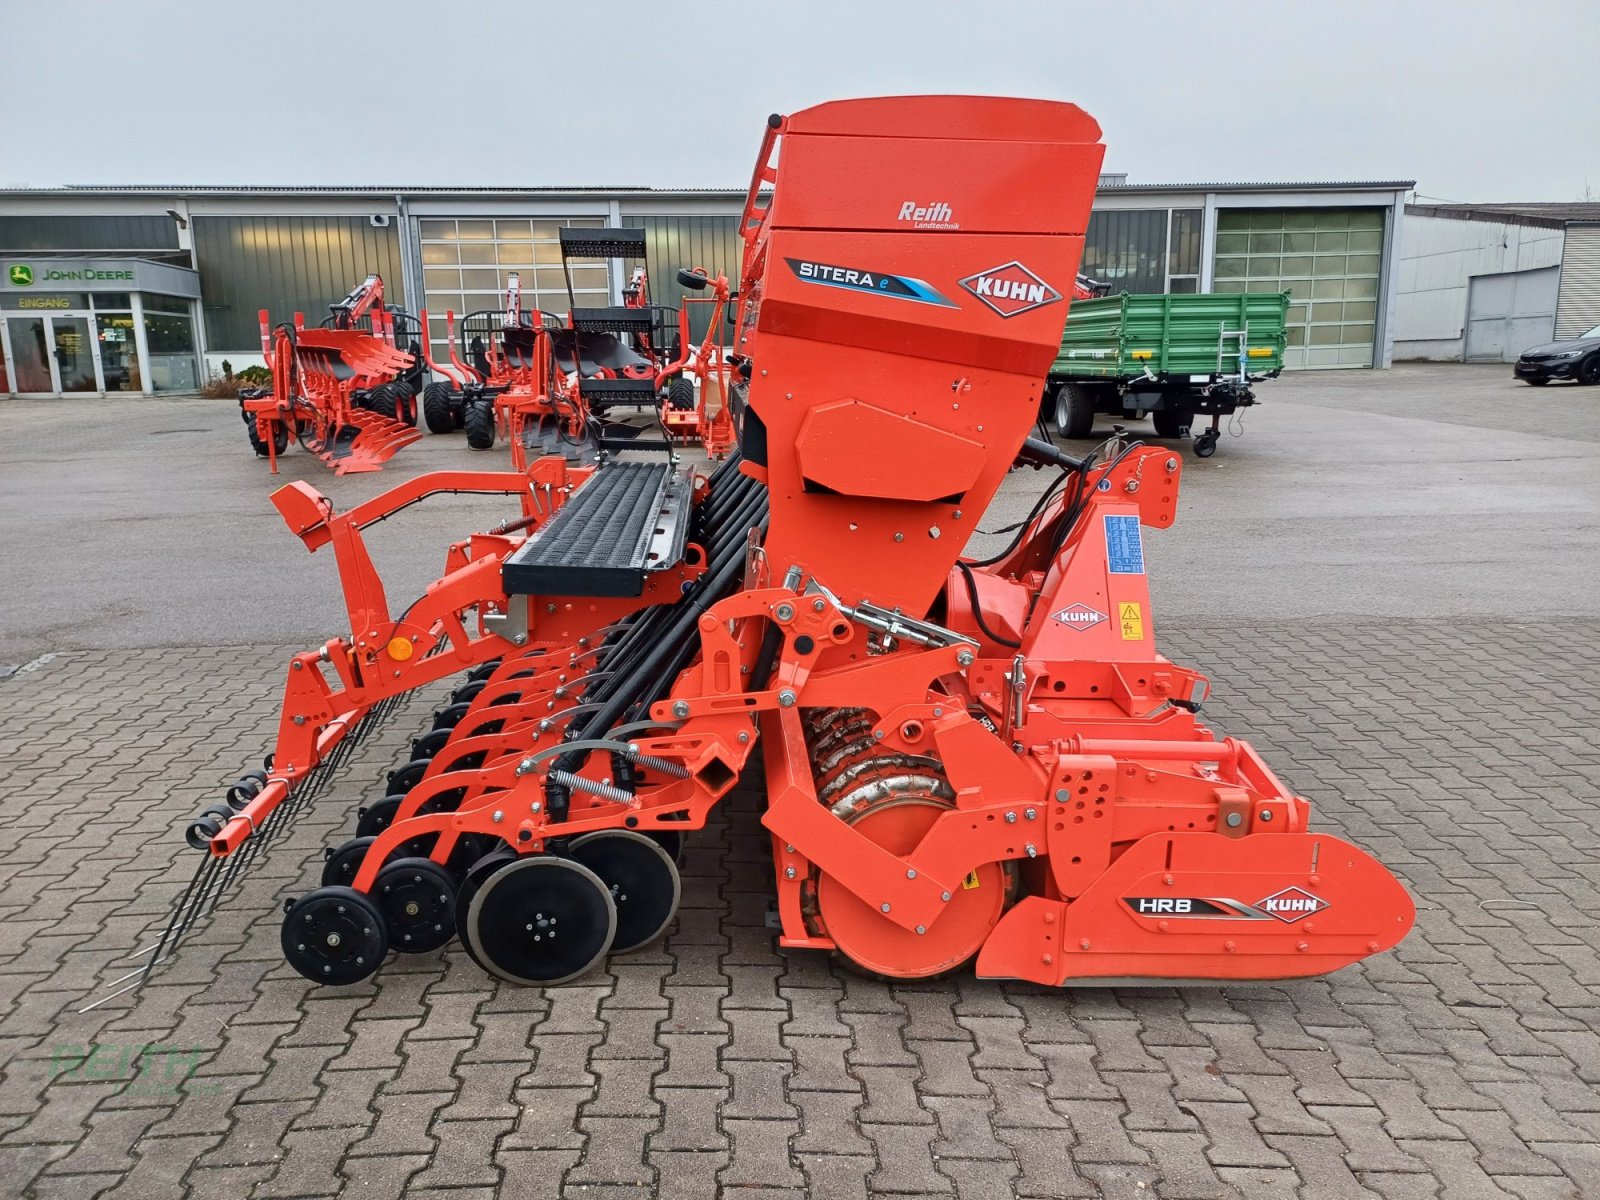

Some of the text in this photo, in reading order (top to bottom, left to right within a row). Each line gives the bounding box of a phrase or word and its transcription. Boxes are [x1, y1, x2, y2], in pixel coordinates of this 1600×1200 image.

[898, 201, 953, 222] Reith
[914, 221, 960, 230] Landtechnik
[42, 269, 134, 281] JOHN DEERE
[799, 262, 874, 287] SITERA
[976, 277, 1046, 303] KUHN
[19, 298, 70, 308] EINGANG
[1061, 612, 1099, 622] KUHN
[1139, 899, 1192, 913] HRB
[1266, 900, 1317, 911] KUHN
